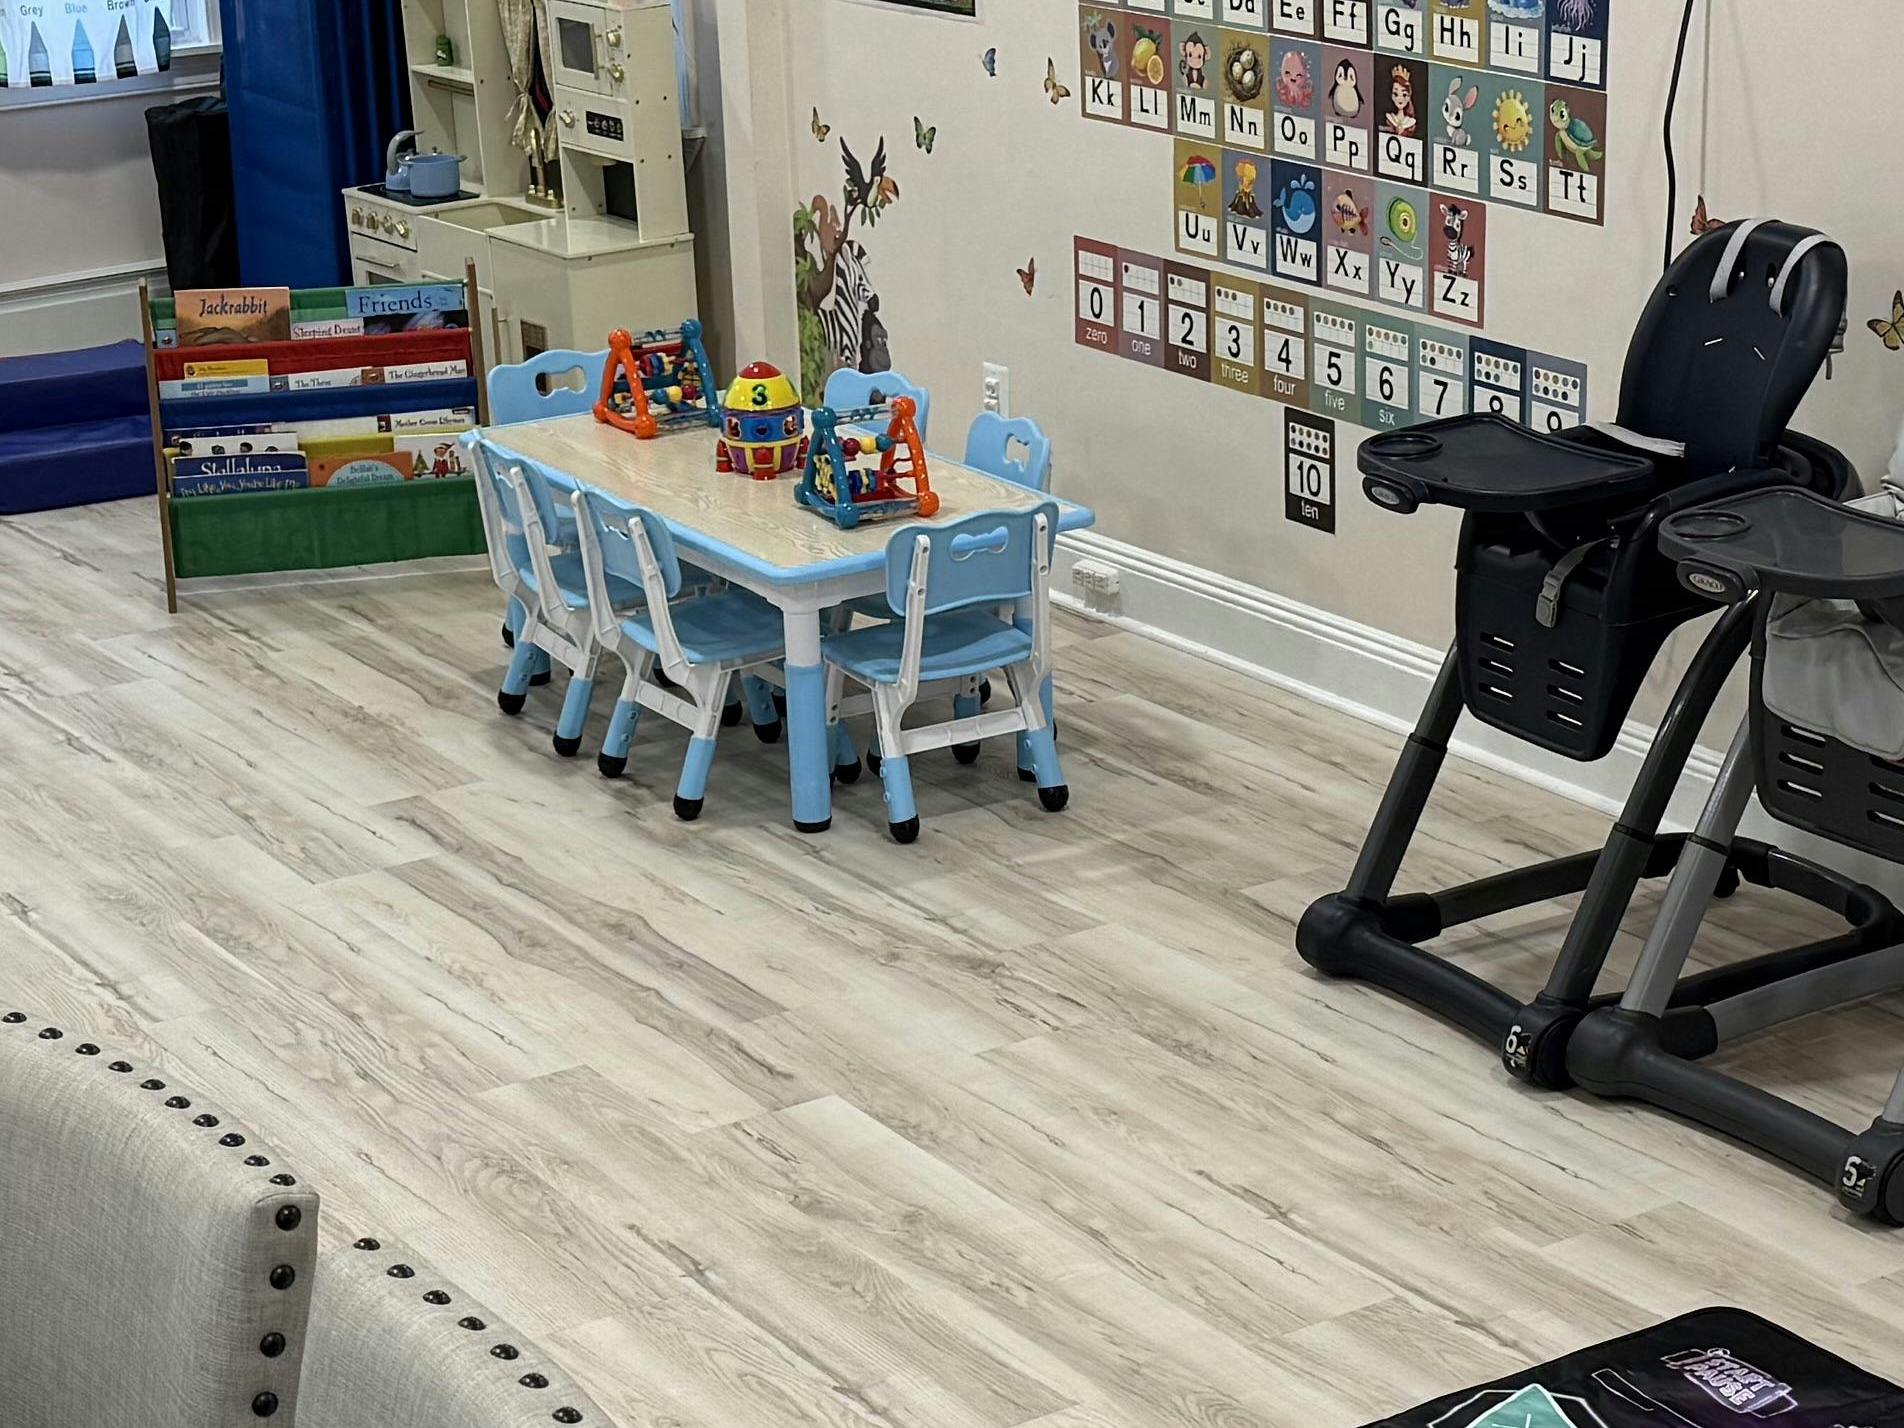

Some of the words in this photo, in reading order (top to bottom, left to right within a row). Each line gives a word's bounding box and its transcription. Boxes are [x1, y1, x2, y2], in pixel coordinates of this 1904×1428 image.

[20, 4, 43, 18] Grey
[1333, 0, 1356, 30] Ff
[1385, 8, 1414, 52] Gg
[1440, 16, 1471, 48] Hh
[1564, 36, 1587, 82] Jj
[1092, 78, 1114, 107] Kk
[1181, 95, 1211, 127] Mm
[1231, 105, 1258, 136] Nn
[1281, 115, 1307, 145] Oo
[1333, 125, 1359, 168] Pp
[1386, 136, 1415, 181] Qq
[1443, 146, 1468, 178] Rr
[1500, 159, 1527, 190] Ss
[1559, 170, 1586, 204] Tt
[1185, 212, 1210, 243] Uu
[1233, 224, 1260, 255] Vv
[1280, 235, 1312, 268] Ww
[1334, 249, 1362, 281] Xx
[1385, 261, 1416, 304] Yy
[1442, 274, 1469, 307] Zz
[200, 294, 267, 317] Jackrabbit
[359, 290, 432, 314] Friends
[1086, 326, 1107, 345] zero
[1132, 339, 1151, 356] one
[1178, 352, 1196, 369] two
[1221, 362, 1248, 383] three
[1273, 374, 1296, 396] four
[1325, 390, 1345, 412] five
[1379, 408, 1396, 425] six
[1138, 299, 1145, 332] 1
[1181, 312, 1194, 346] 2
[1228, 324, 1240, 359] 3
[1278, 338, 1292, 373] 4
[1327, 351, 1341, 386] 5
[1379, 366, 1394, 401] 6
[1433, 379, 1448, 415] 7
[752, 384, 767, 405] 3
[1297, 460, 1322, 498] 10
[1301, 502, 1319, 521] ten
